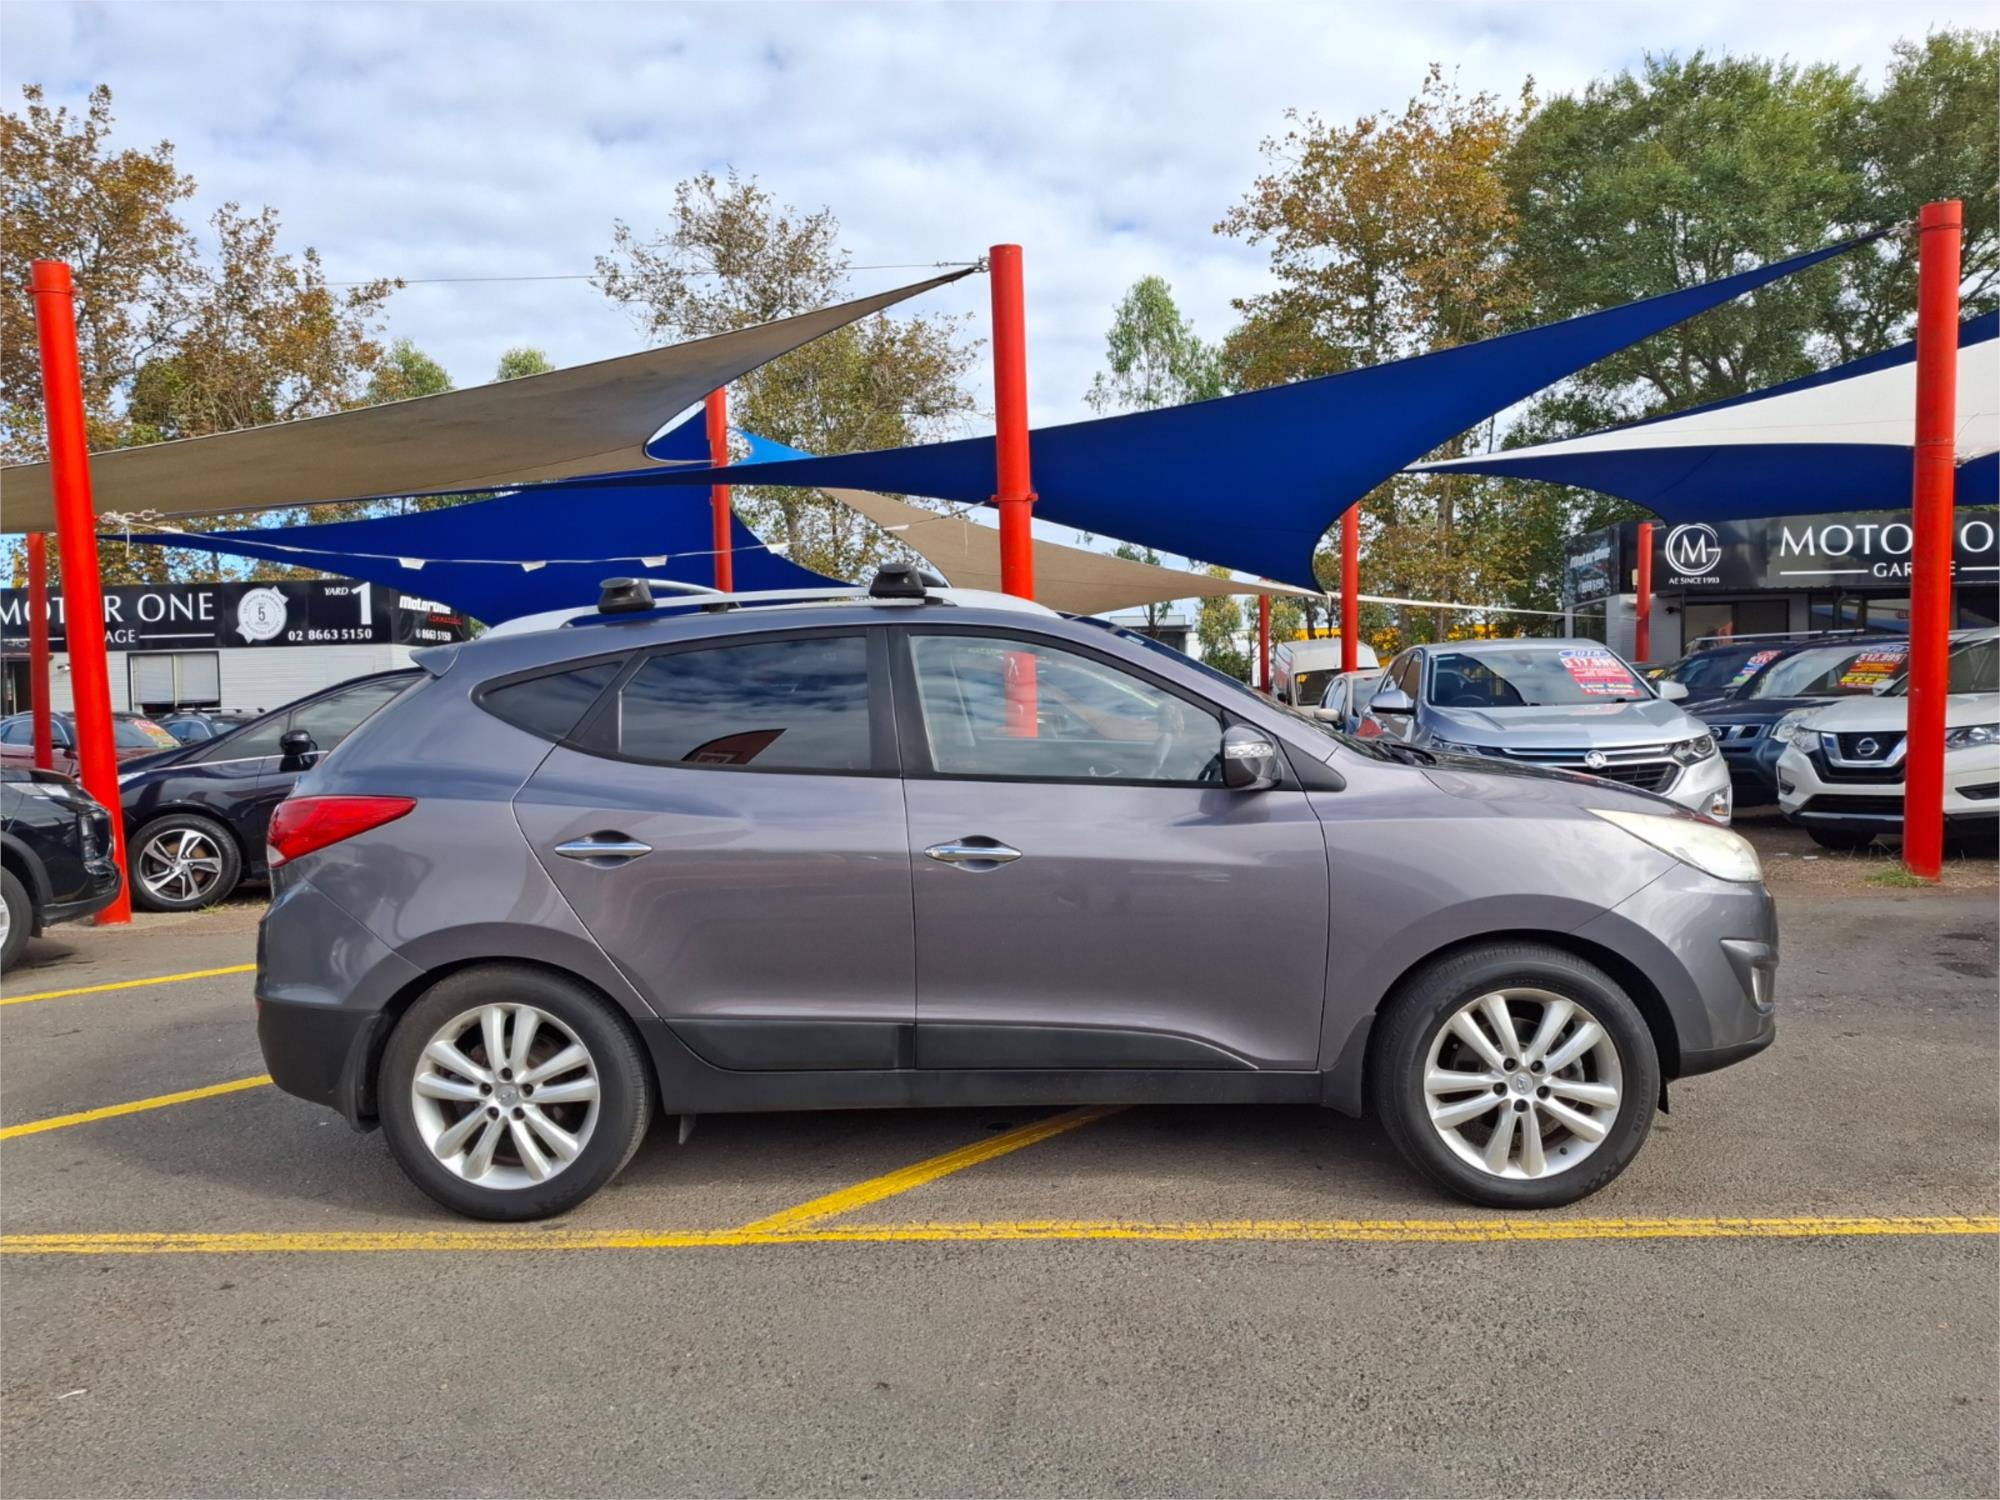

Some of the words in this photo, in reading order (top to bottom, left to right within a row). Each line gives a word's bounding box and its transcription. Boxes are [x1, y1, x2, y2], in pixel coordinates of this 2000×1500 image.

[1780, 523, 1913, 557] MOTO
[1680, 577, 1702, 585] SINCE
[0, 594, 124, 626] MTR
[137, 592, 216, 622] ONE
[324, 586, 350, 596] YARD
[351, 581, 372, 625] 1
[258, 606, 266, 622] 5
[104, 629, 136, 644] AGE
[288, 630, 304, 642] 02
[308, 628, 339, 641] 8663
[341, 628, 373, 640] 5150
